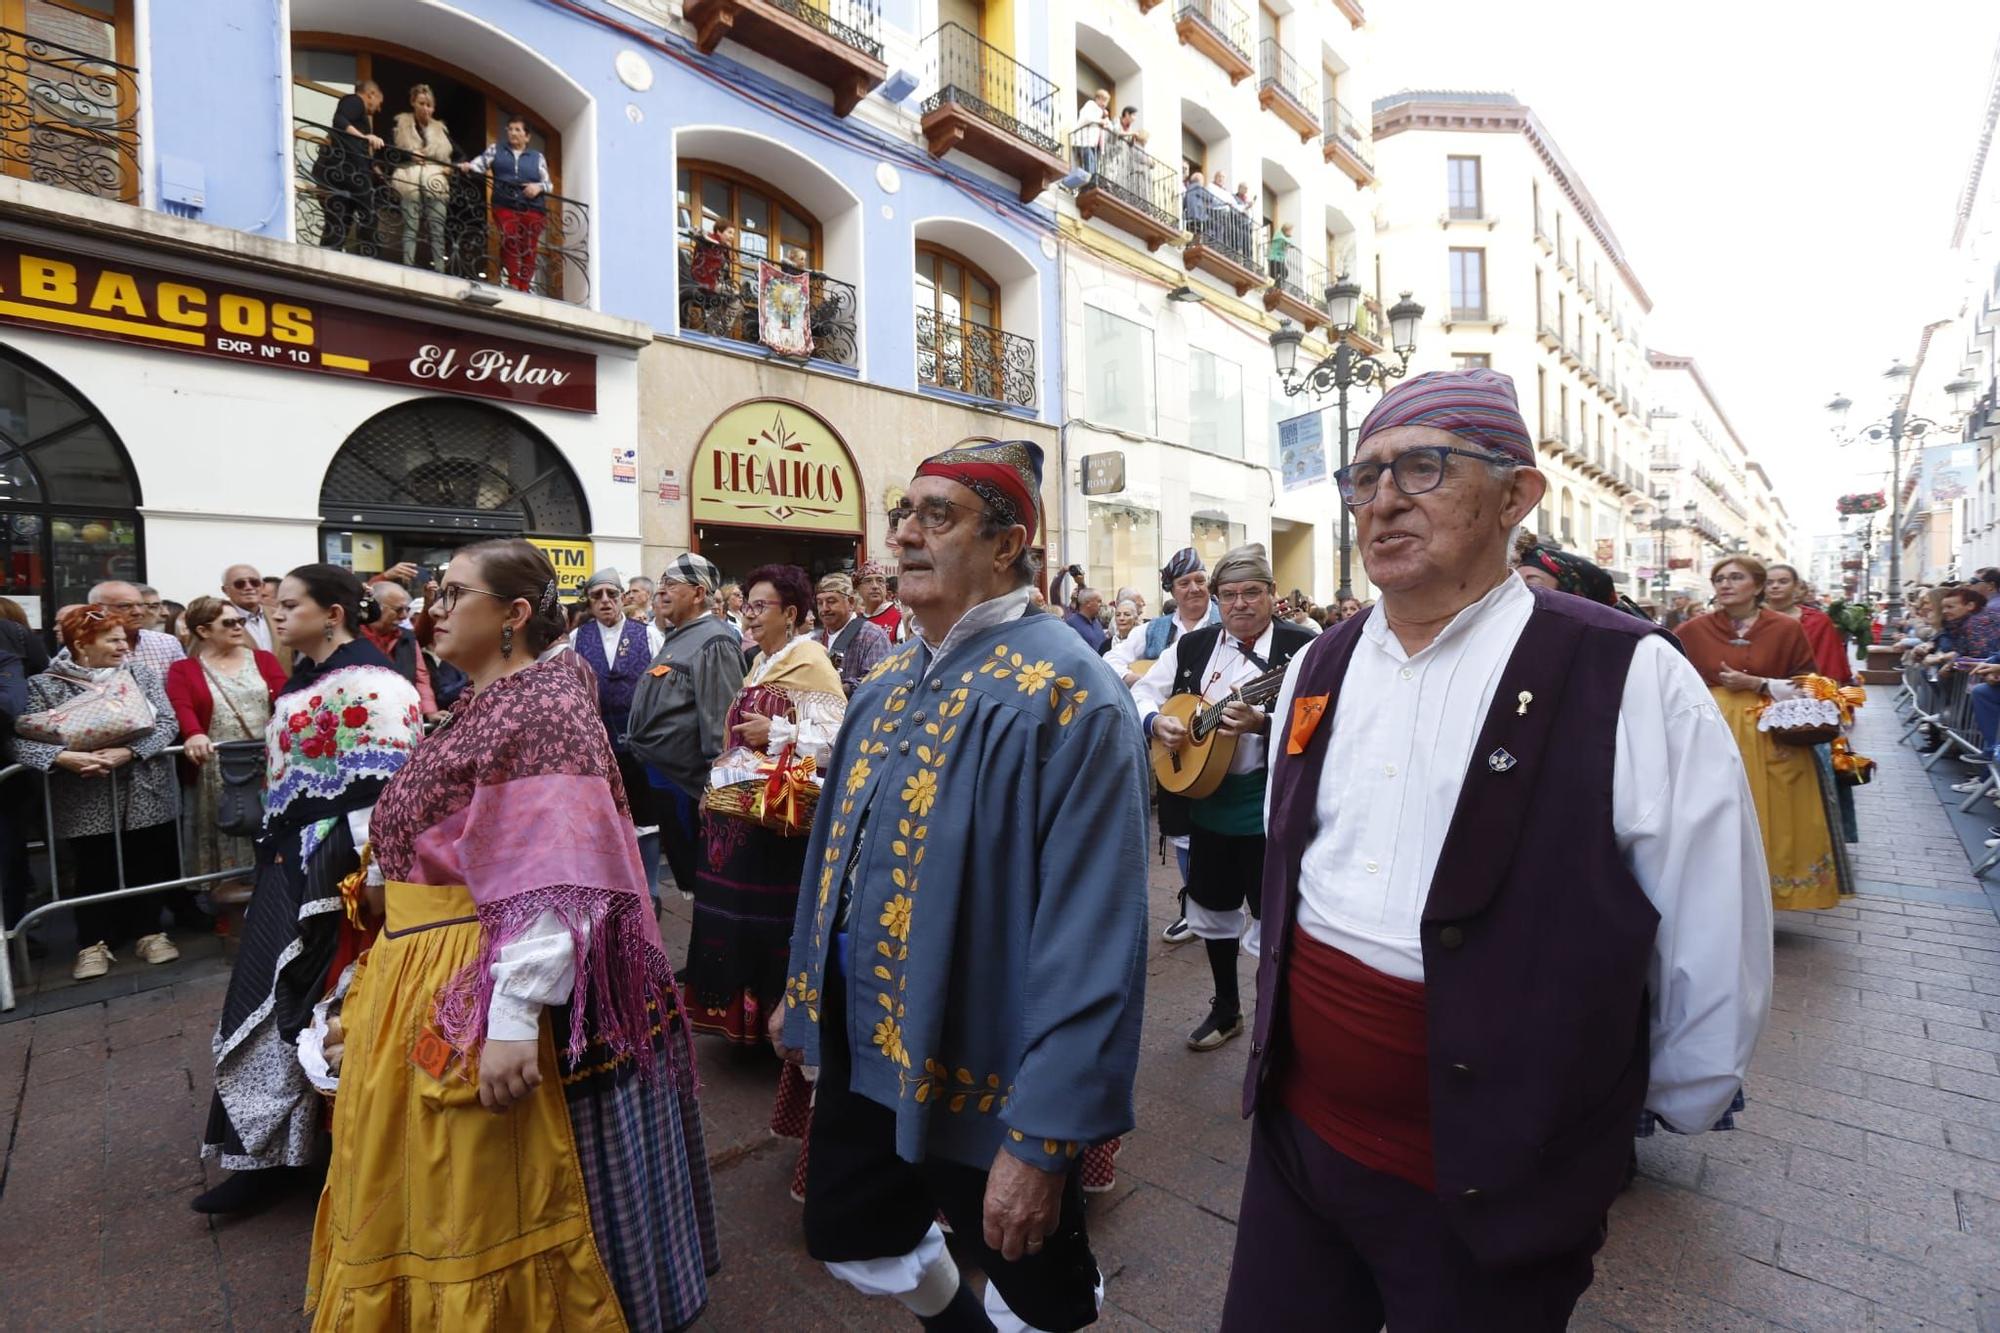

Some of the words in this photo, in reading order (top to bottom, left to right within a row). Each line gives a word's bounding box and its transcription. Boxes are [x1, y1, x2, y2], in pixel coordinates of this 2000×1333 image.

[0, 254, 315, 346] BACOS
[217, 337, 254, 355] EXP.
[288, 349, 310, 363] 10
[409, 344, 459, 380] El
[465, 349, 571, 386] Pilar
[713, 450, 843, 504] REGALICOS
